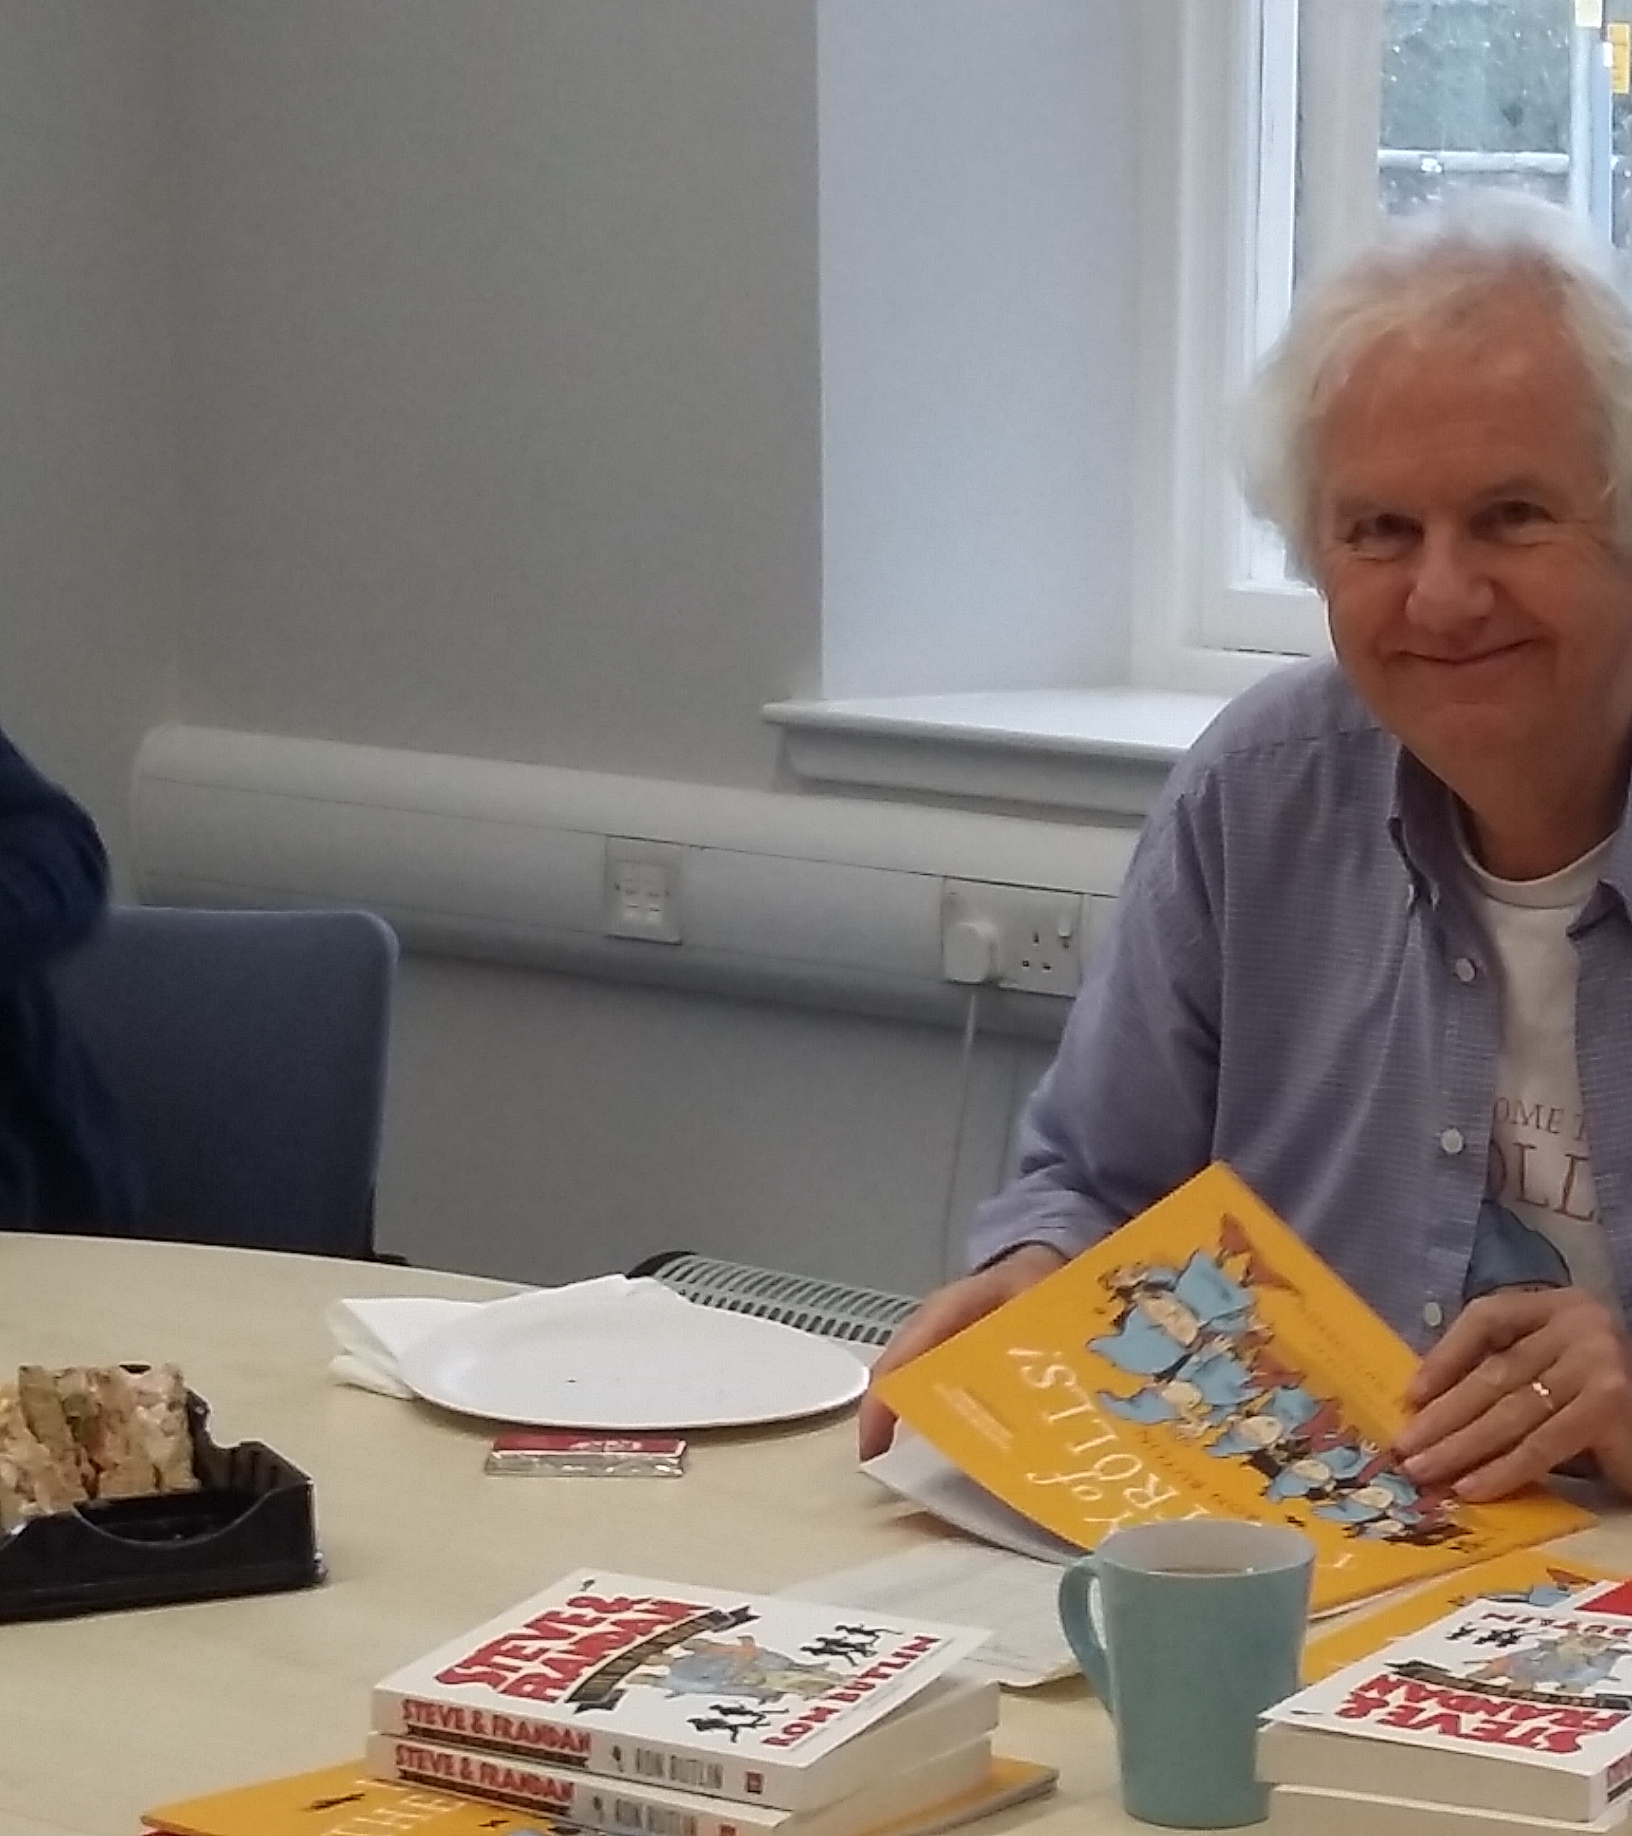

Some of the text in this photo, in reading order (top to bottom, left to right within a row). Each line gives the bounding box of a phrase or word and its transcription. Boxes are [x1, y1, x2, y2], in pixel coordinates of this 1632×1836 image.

[433, 1609, 611, 1691] STEVE
[498, 1598, 716, 1703] FRANDAN
[760, 1706, 841, 1747] RON
[822, 1634, 942, 1703] BUTLIN
[1350, 1673, 1632, 1733] FRANDAN
[402, 1699, 466, 1728] STEVE
[491, 1715, 593, 1752] FRANDAN
[1375, 1704, 1583, 1753] STEVE
[395, 1743, 456, 1776] STEVE
